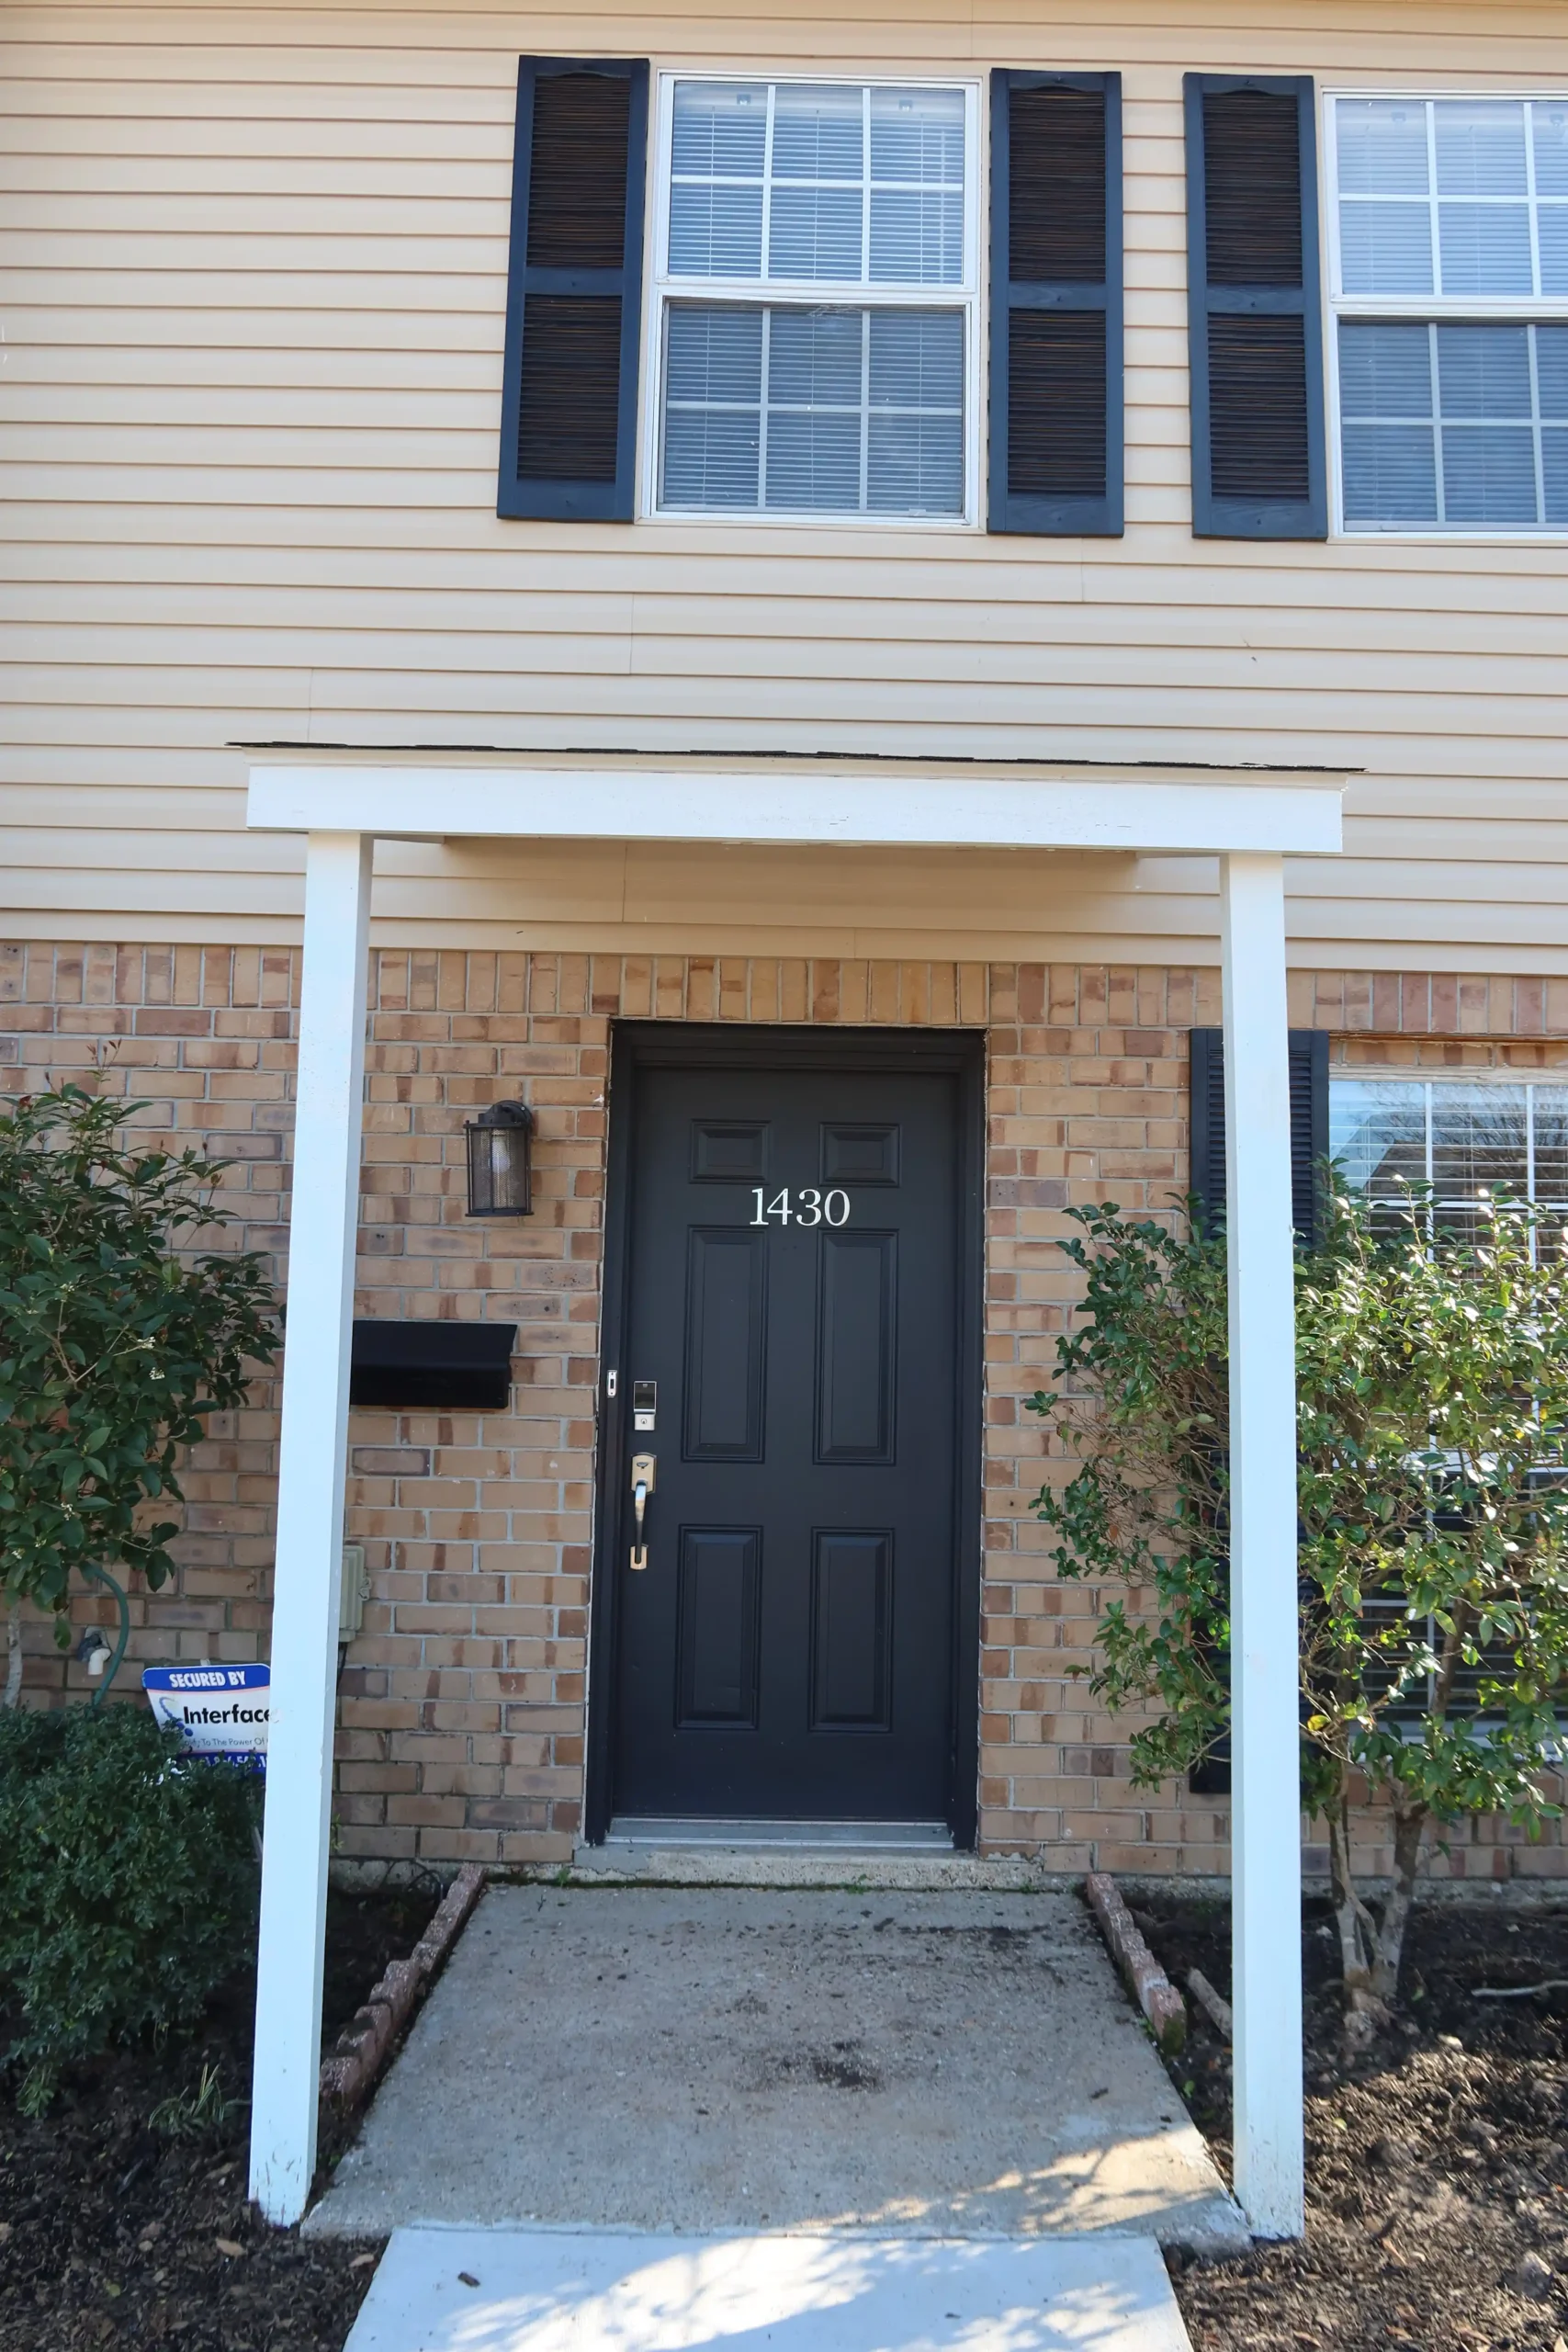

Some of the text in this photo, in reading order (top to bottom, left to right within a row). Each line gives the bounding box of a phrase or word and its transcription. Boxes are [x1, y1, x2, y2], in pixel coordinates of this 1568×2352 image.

[750, 1188, 851, 1227] 1430
[169, 1670, 246, 1688] SECURED BY
[254, 1736, 265, 1746] Of
